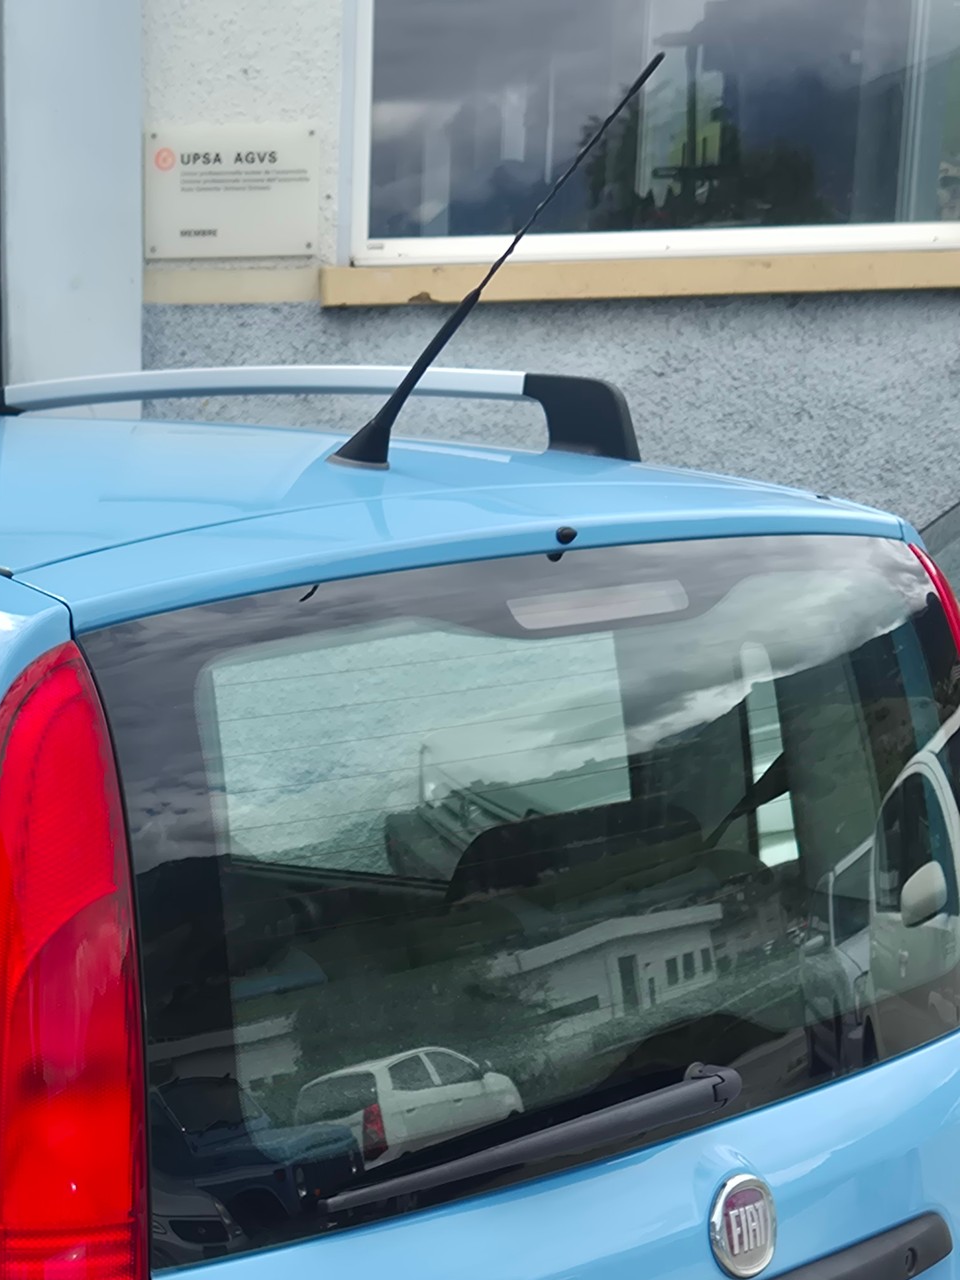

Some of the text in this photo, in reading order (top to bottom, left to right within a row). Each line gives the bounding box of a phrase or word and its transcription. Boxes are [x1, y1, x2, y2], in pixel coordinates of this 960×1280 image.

[180, 151, 278, 165] UPSA AGVS
[180, 229, 218, 238] MEMBRE
[729, 1200, 767, 1255] FIAT
